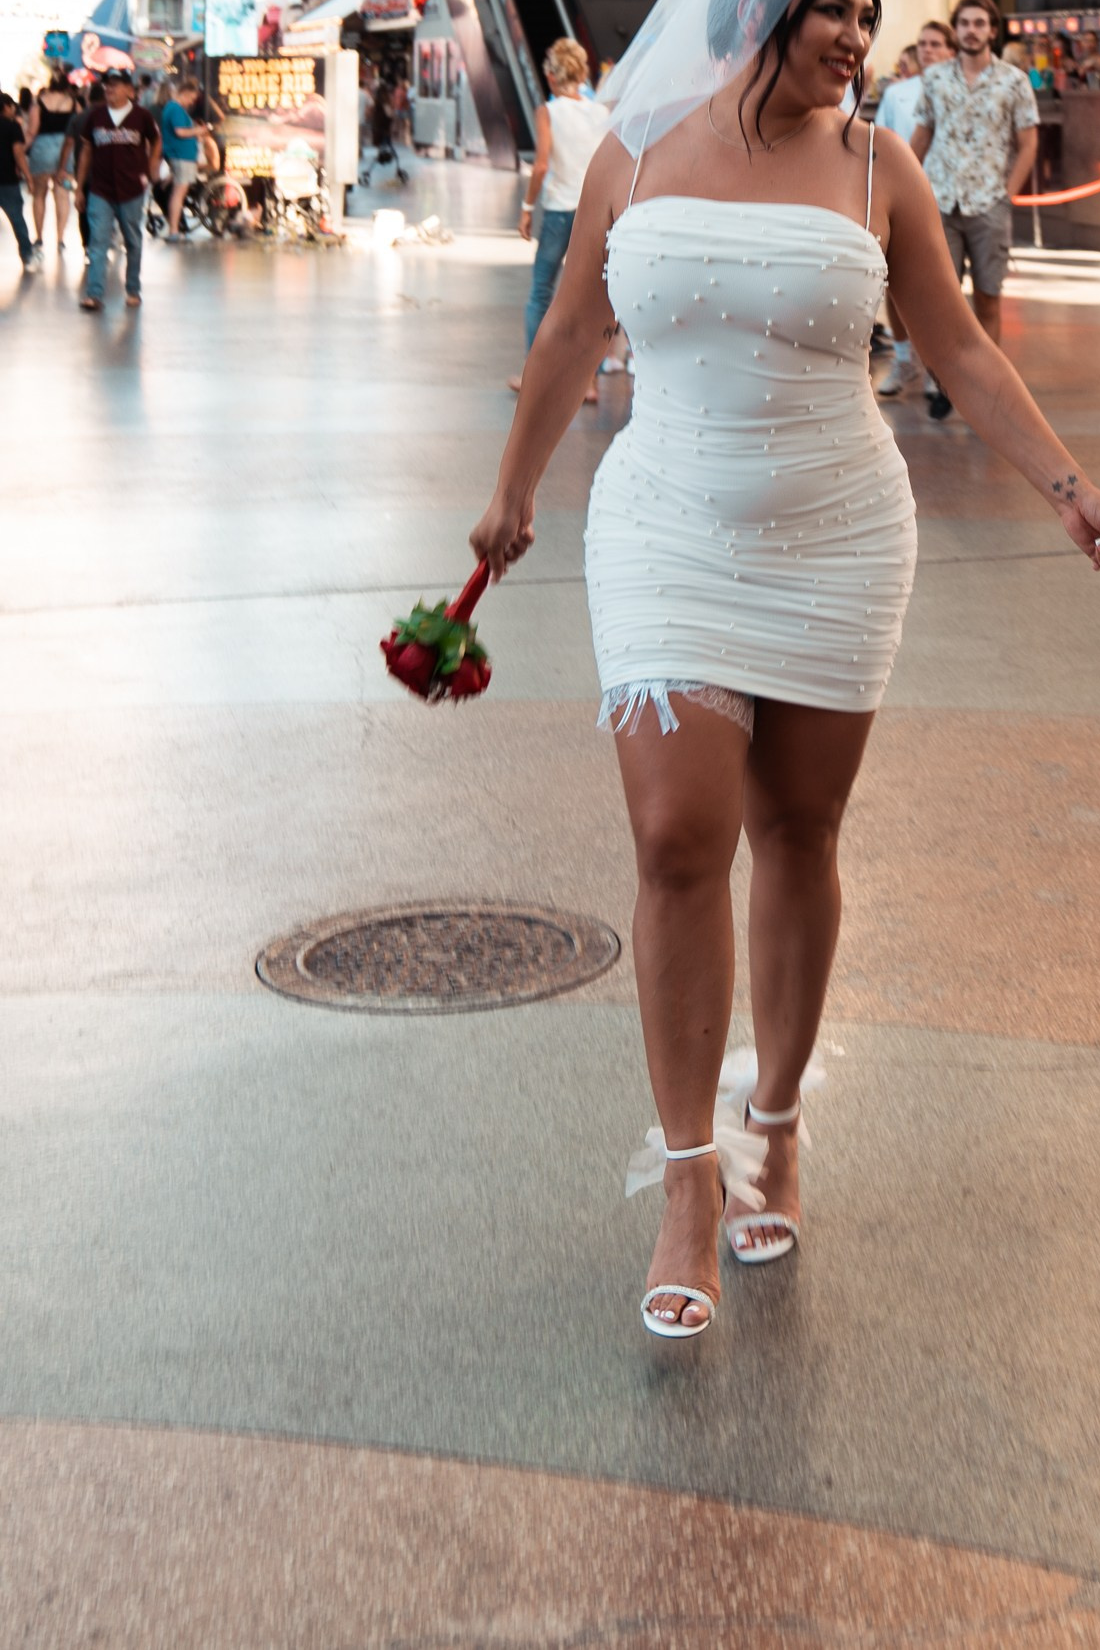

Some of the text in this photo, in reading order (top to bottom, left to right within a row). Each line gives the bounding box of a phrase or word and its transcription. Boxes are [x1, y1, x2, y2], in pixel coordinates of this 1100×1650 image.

[219, 73, 316, 95] PRIME RIB
[228, 93, 306, 110] BUFFET
